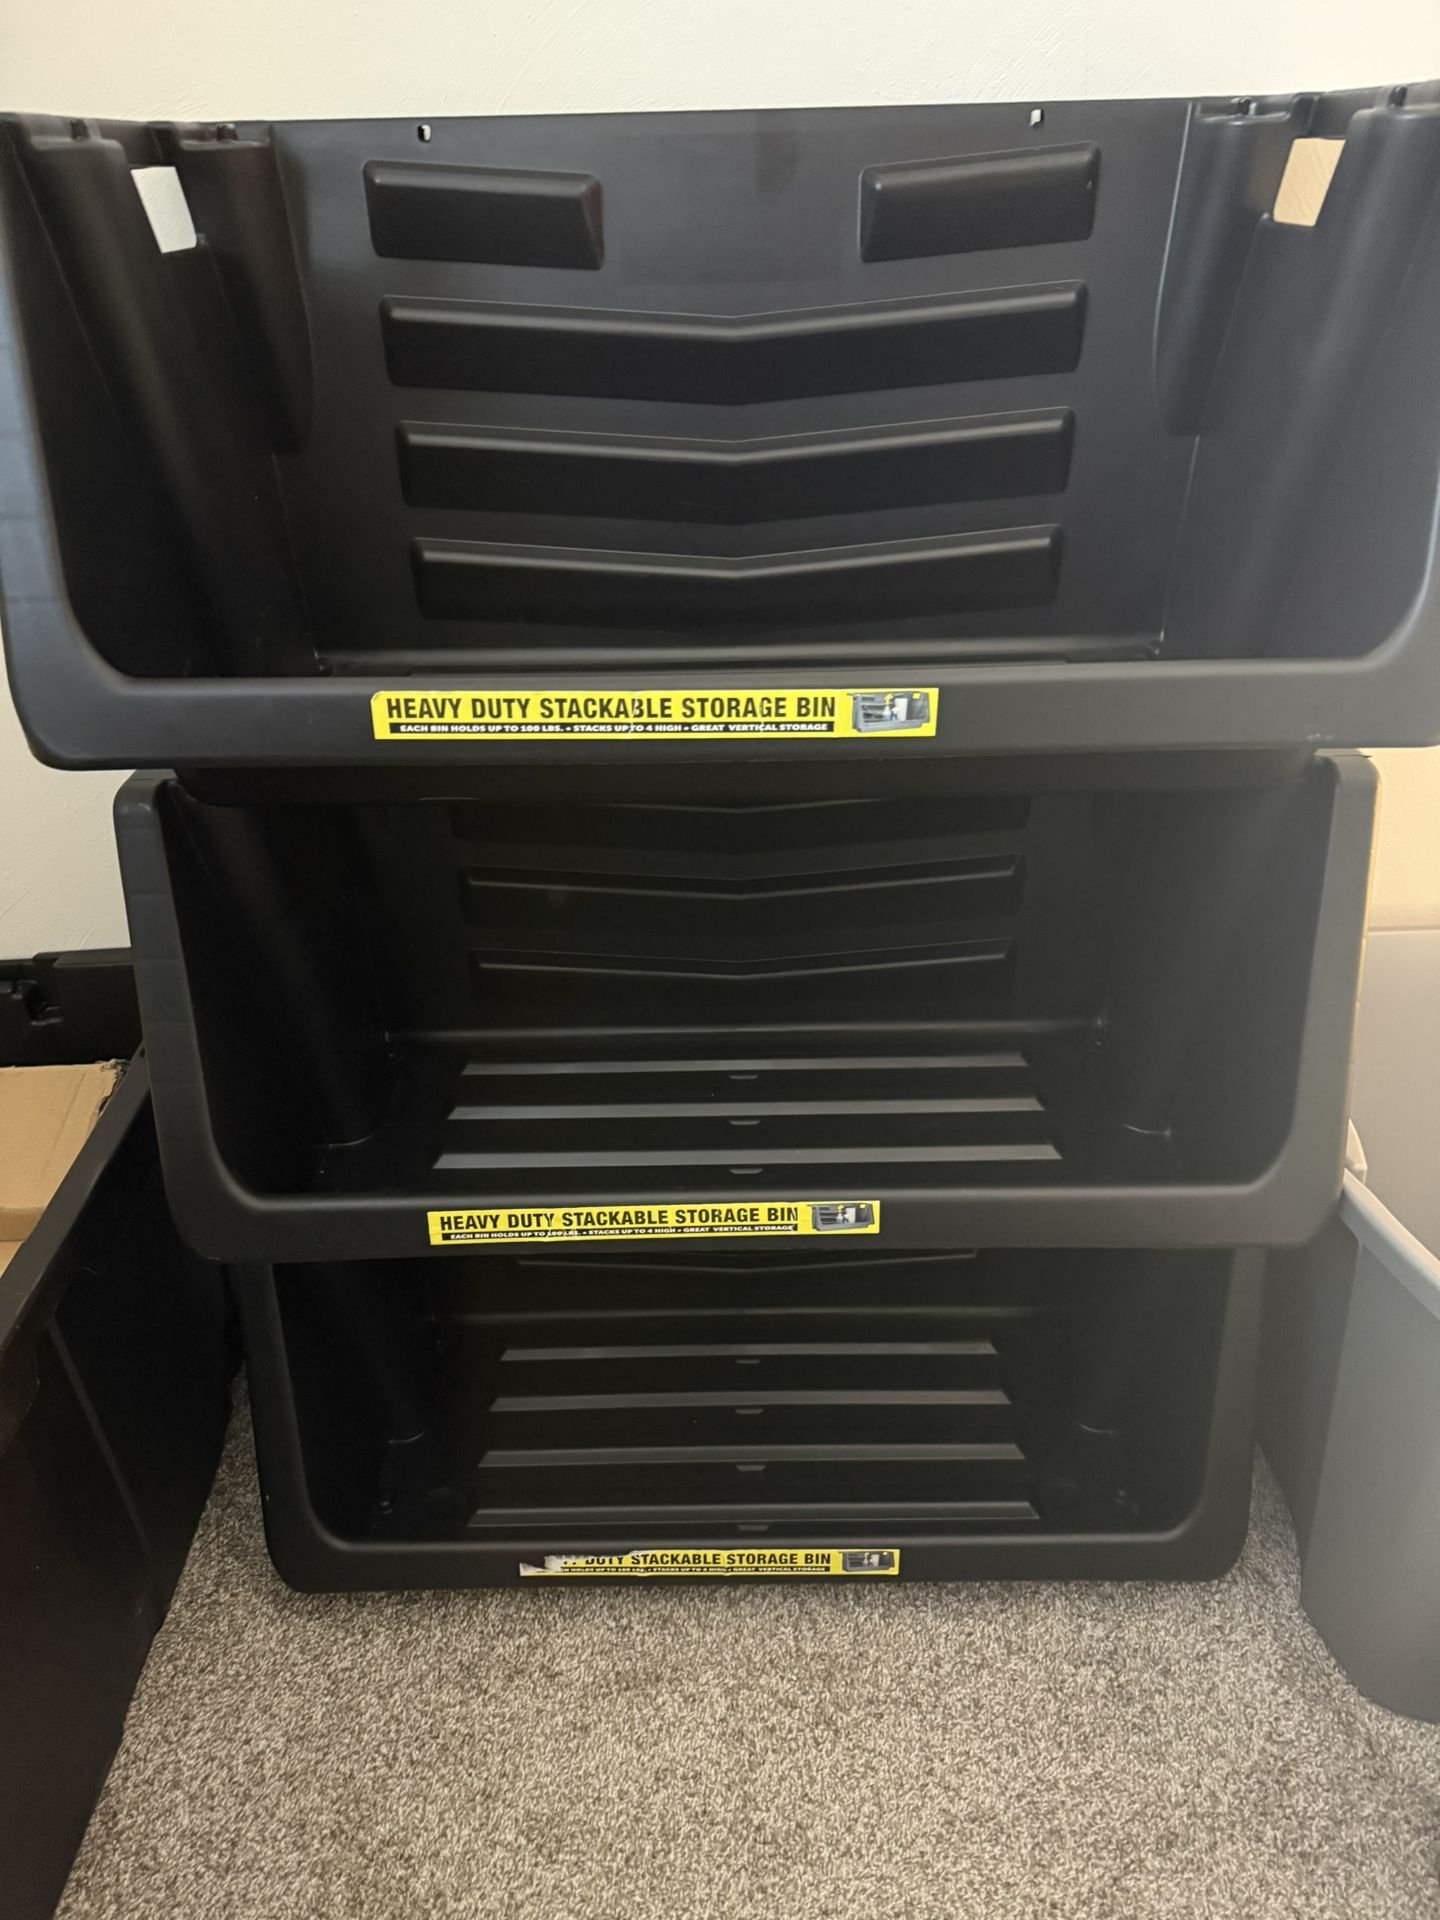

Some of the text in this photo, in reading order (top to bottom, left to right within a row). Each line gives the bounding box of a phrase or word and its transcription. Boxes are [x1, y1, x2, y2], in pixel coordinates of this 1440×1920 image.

[386, 697, 836, 719] HEAVY DUTY STACKABLE STORAGE BIN
[400, 724, 428, 732] EACH
[430, 724, 449, 732] BIN
[451, 724, 486, 732] HOLDS
[488, 724, 502, 732] UP
[504, 724, 519, 732] TO
[520, 724, 540, 732] 100
[542, 724, 564, 732] LBS.
[691, 724, 726, 732] GREAT
[728, 723, 777, 732] VERTICAL
[779, 723, 828, 731] STORAGE
[440, 1206, 798, 1231] HEAVY DUTY STACKABLE STORAGE BIN
[585, 1556, 624, 1565] DUTY
[631, 1554, 721, 1565] STACKABLE
[726, 1553, 798, 1564] STORAGE
[804, 1553, 831, 1564] BIN
